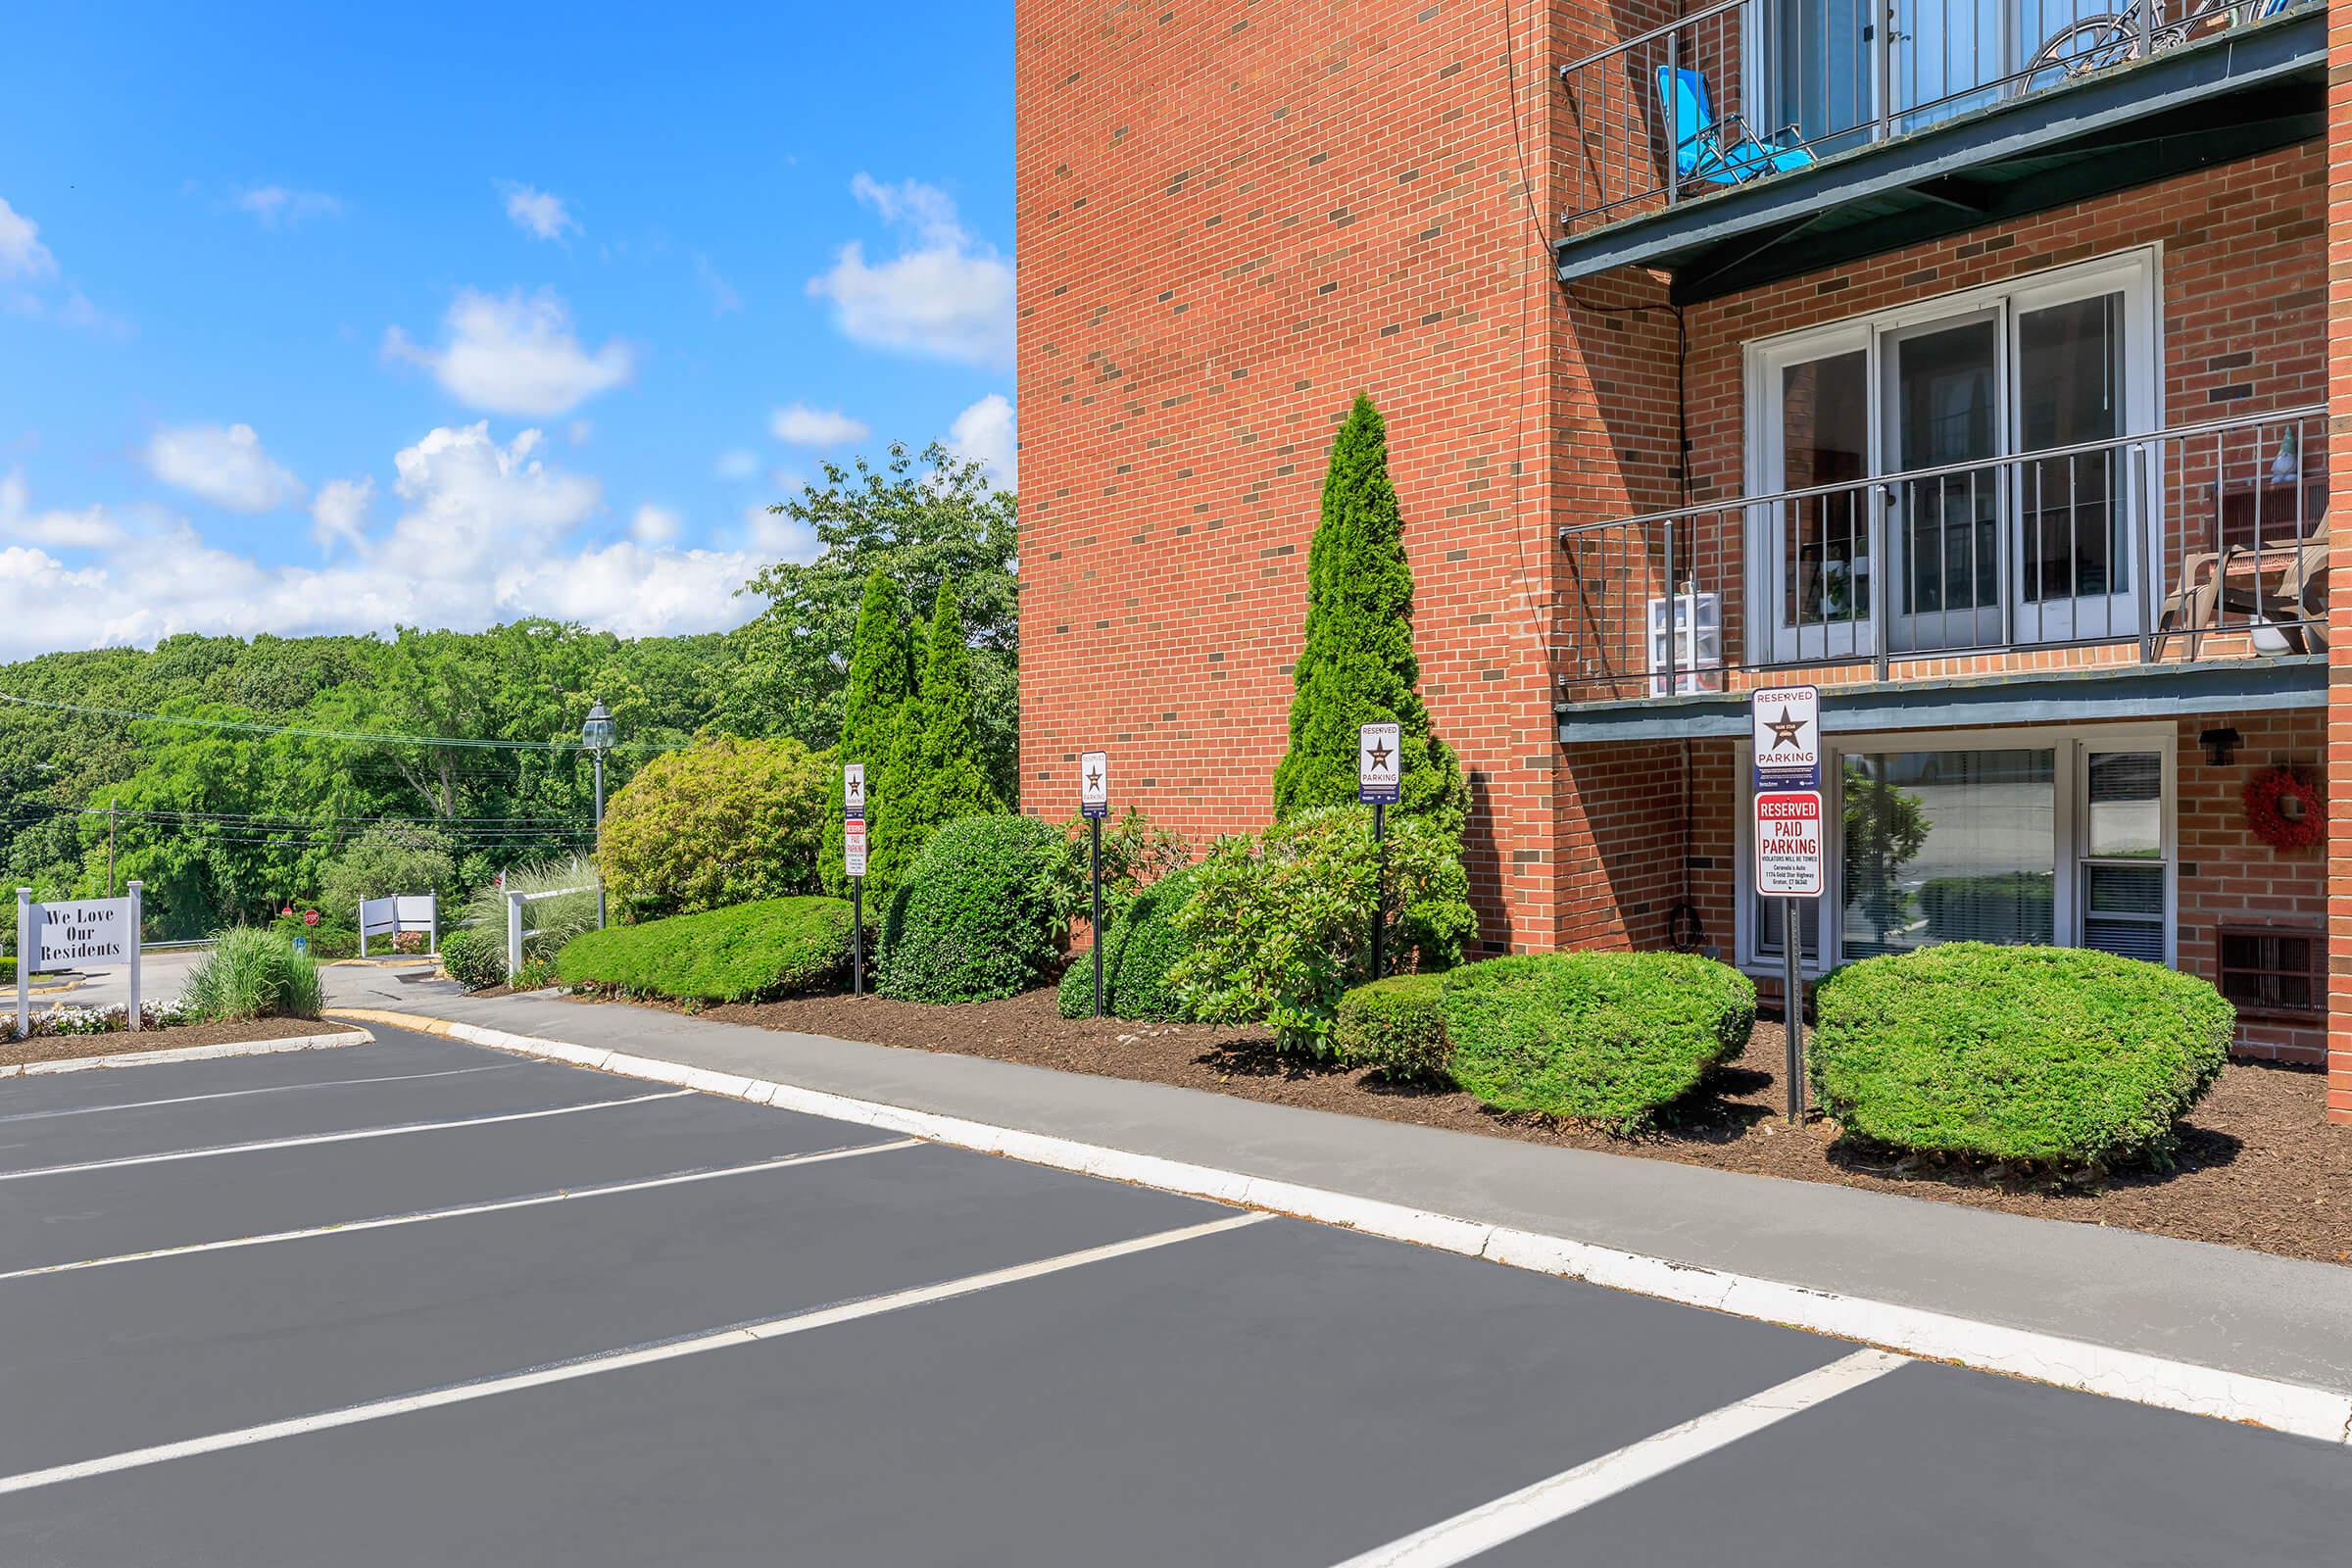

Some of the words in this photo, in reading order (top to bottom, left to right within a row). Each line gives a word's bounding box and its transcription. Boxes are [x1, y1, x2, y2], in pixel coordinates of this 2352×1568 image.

[1757, 691, 1813, 703] RESERVED
[1758, 753, 1814, 763] PARKING
[1362, 773, 1396, 782] PARKING
[1761, 802, 1816, 817] RESERVED
[1775, 821, 1802, 837] PAID
[1763, 839, 1817, 855] PARKING
[46, 909, 71, 925] We
[77, 908, 115, 923] Love
[67, 926, 95, 942] Our
[41, 942, 120, 960] Residents
